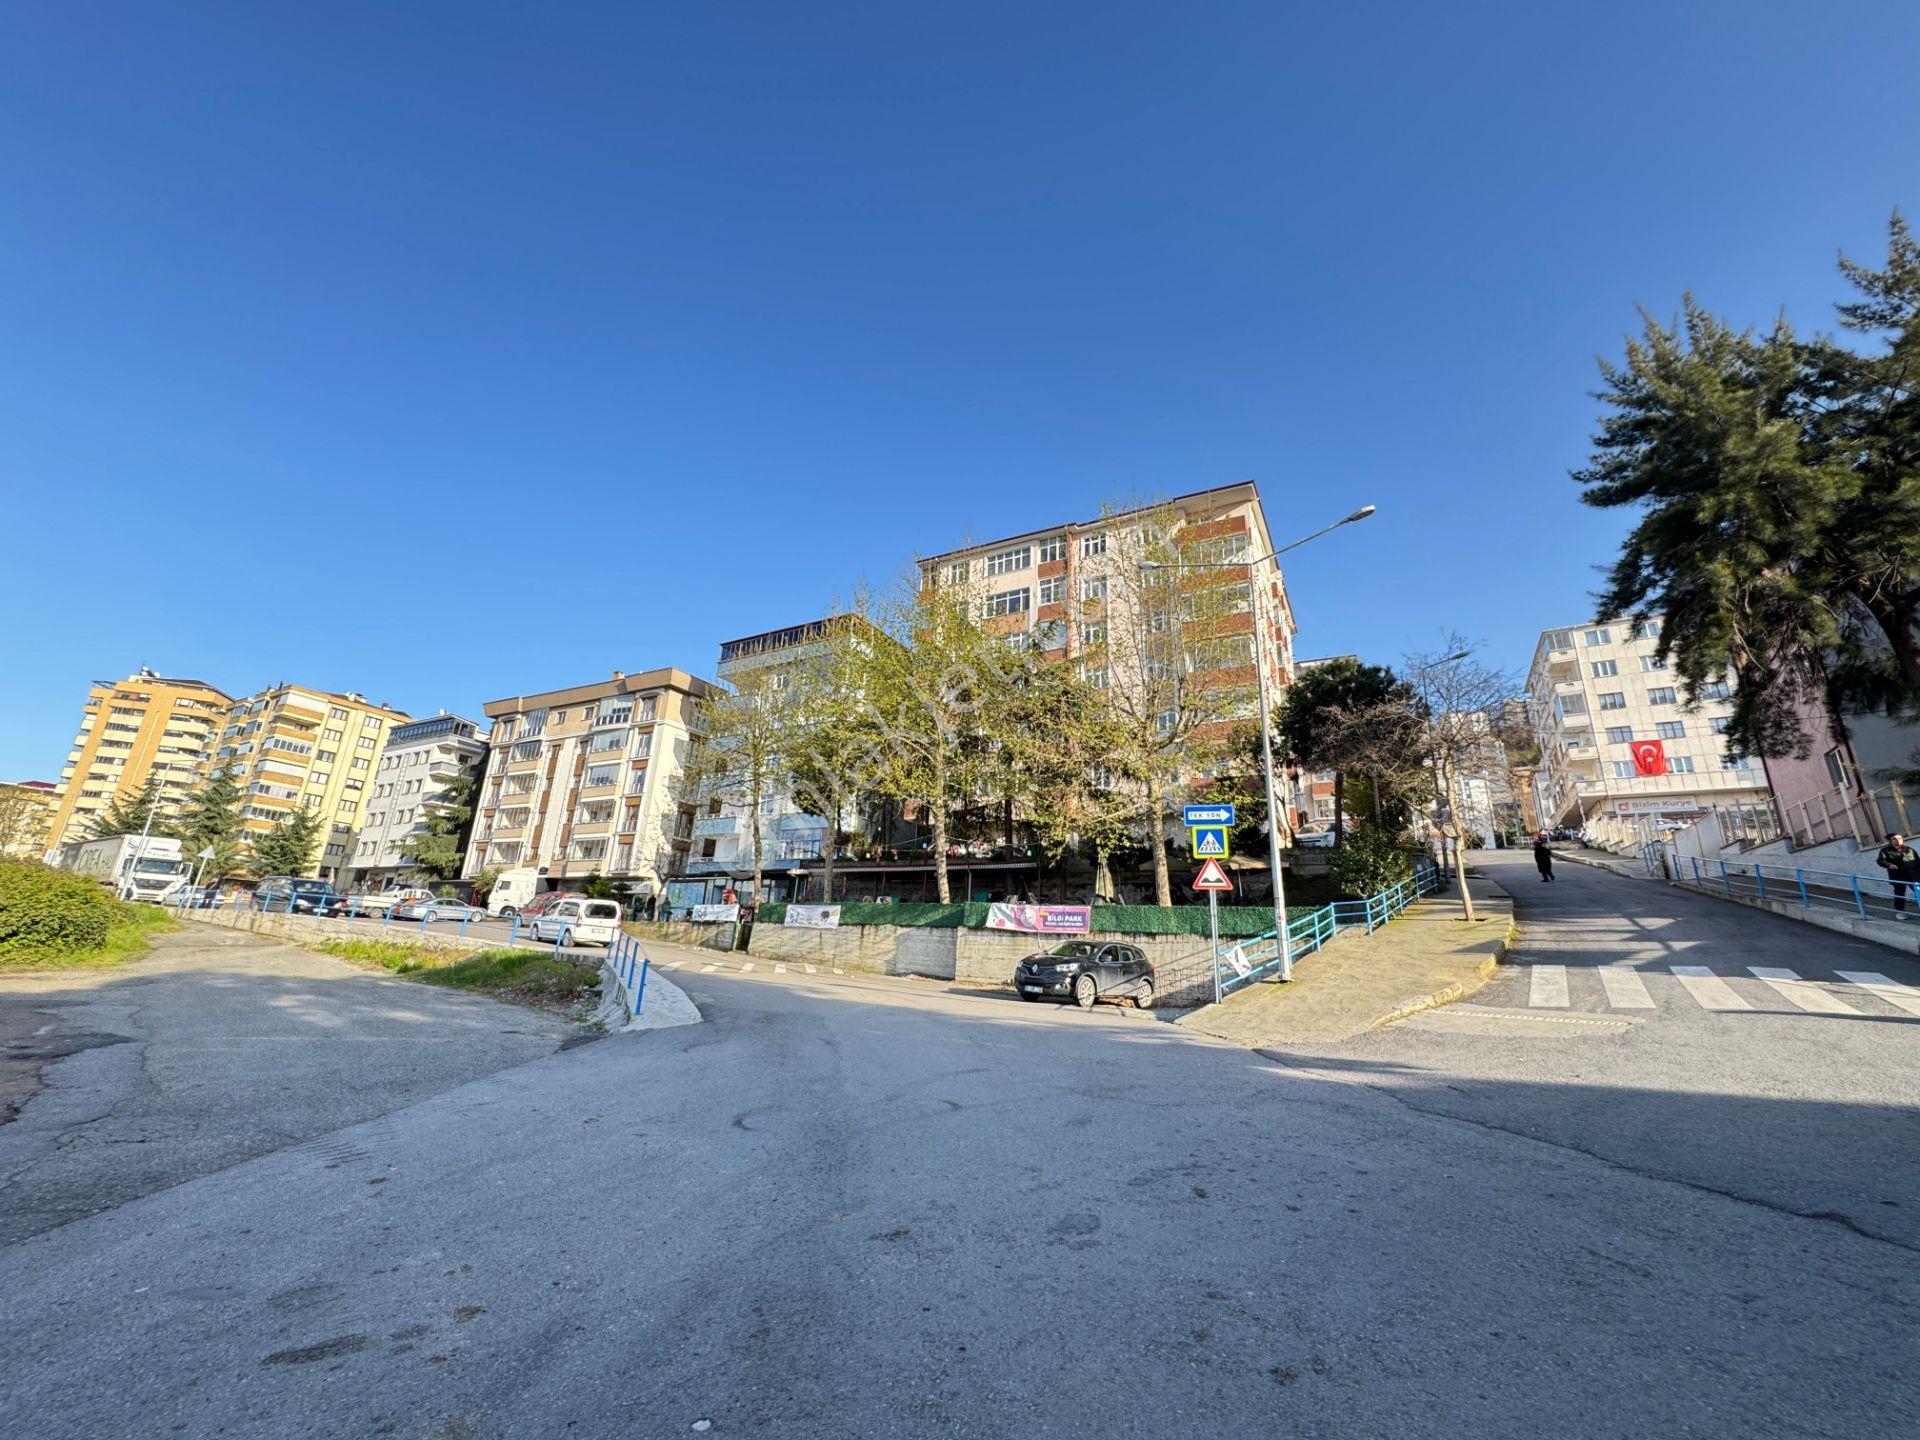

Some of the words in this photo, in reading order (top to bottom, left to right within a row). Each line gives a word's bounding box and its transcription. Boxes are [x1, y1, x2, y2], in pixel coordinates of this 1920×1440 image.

[1631, 800, 1660, 809] Bizim
[1662, 799, 1692, 808] Kurye
[1206, 811, 1221, 819] YÖN
[1064, 914, 1083, 922] PARK
